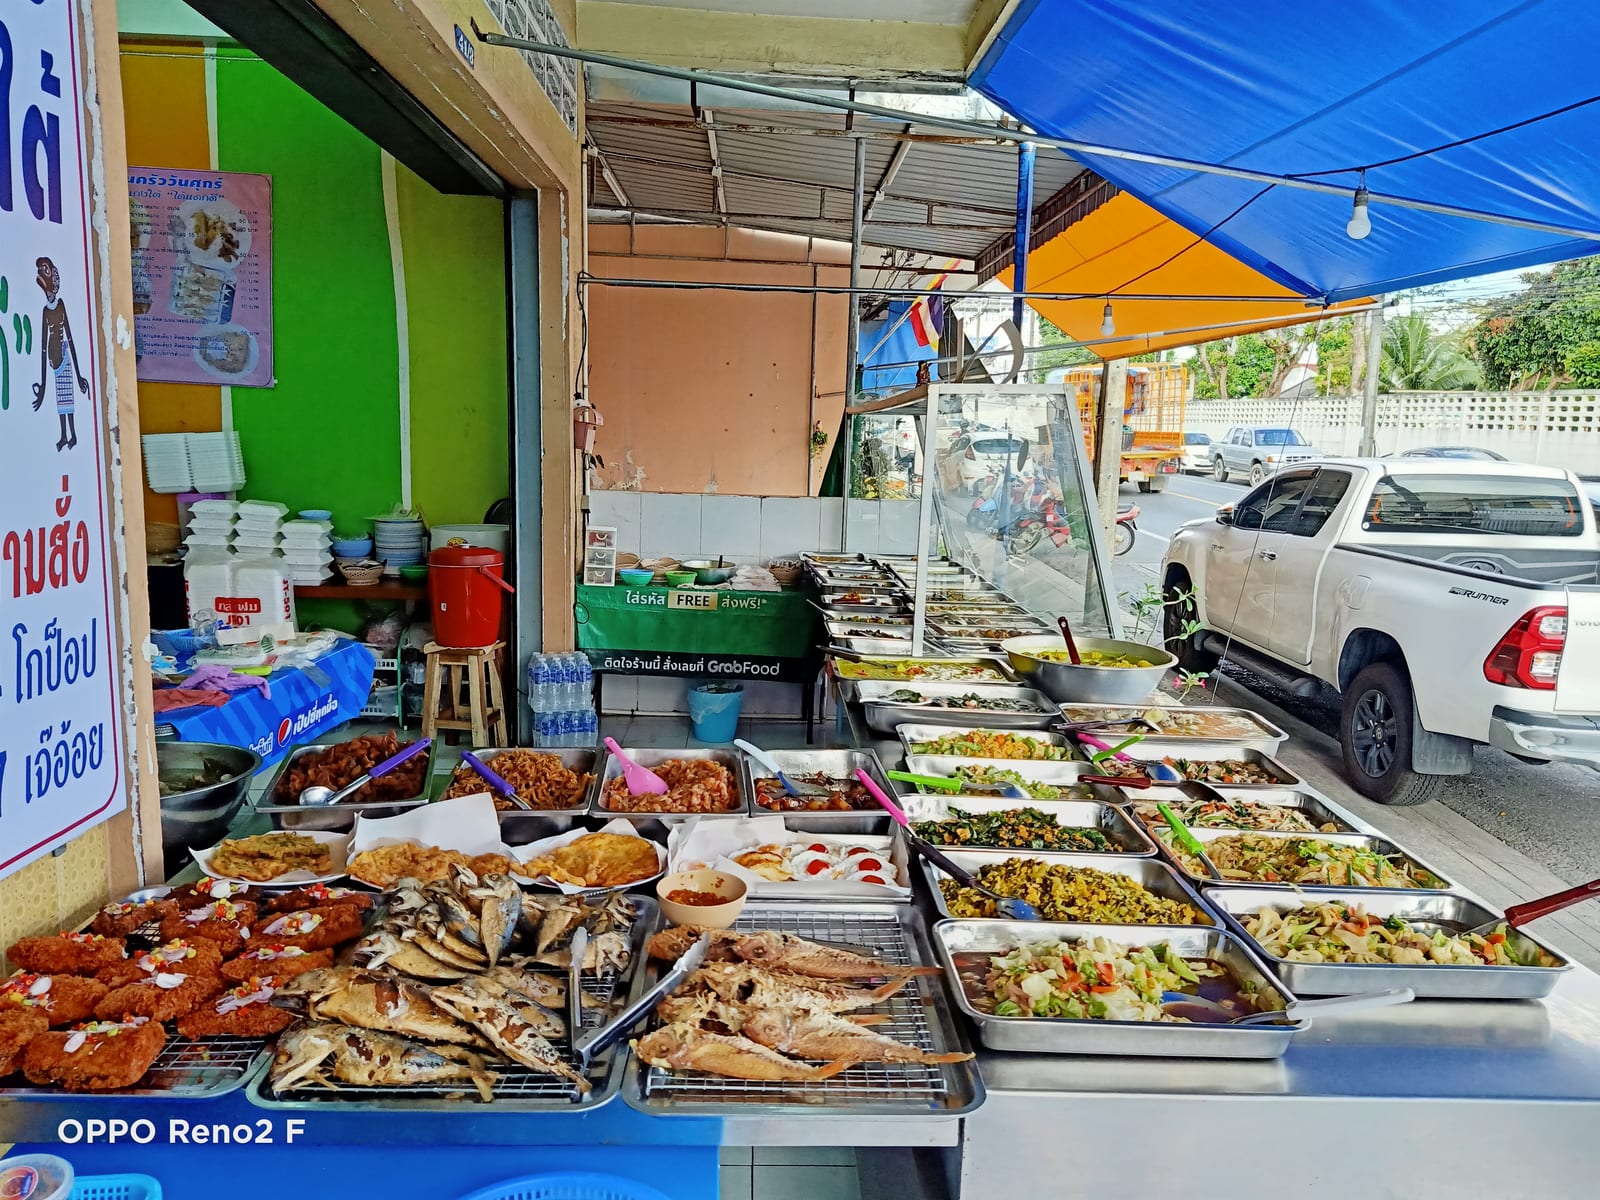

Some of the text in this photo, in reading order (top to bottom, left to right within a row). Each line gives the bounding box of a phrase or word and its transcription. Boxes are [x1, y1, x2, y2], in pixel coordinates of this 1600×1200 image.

[677, 594, 710, 607] FREE
[12, 616, 97, 704] โกป็อป
[604, 656, 781, 676] ติดใจร้านนี้ สั่งเลยที่ GrabFood
[25, 719, 104, 805] เจ๊อ้อย
